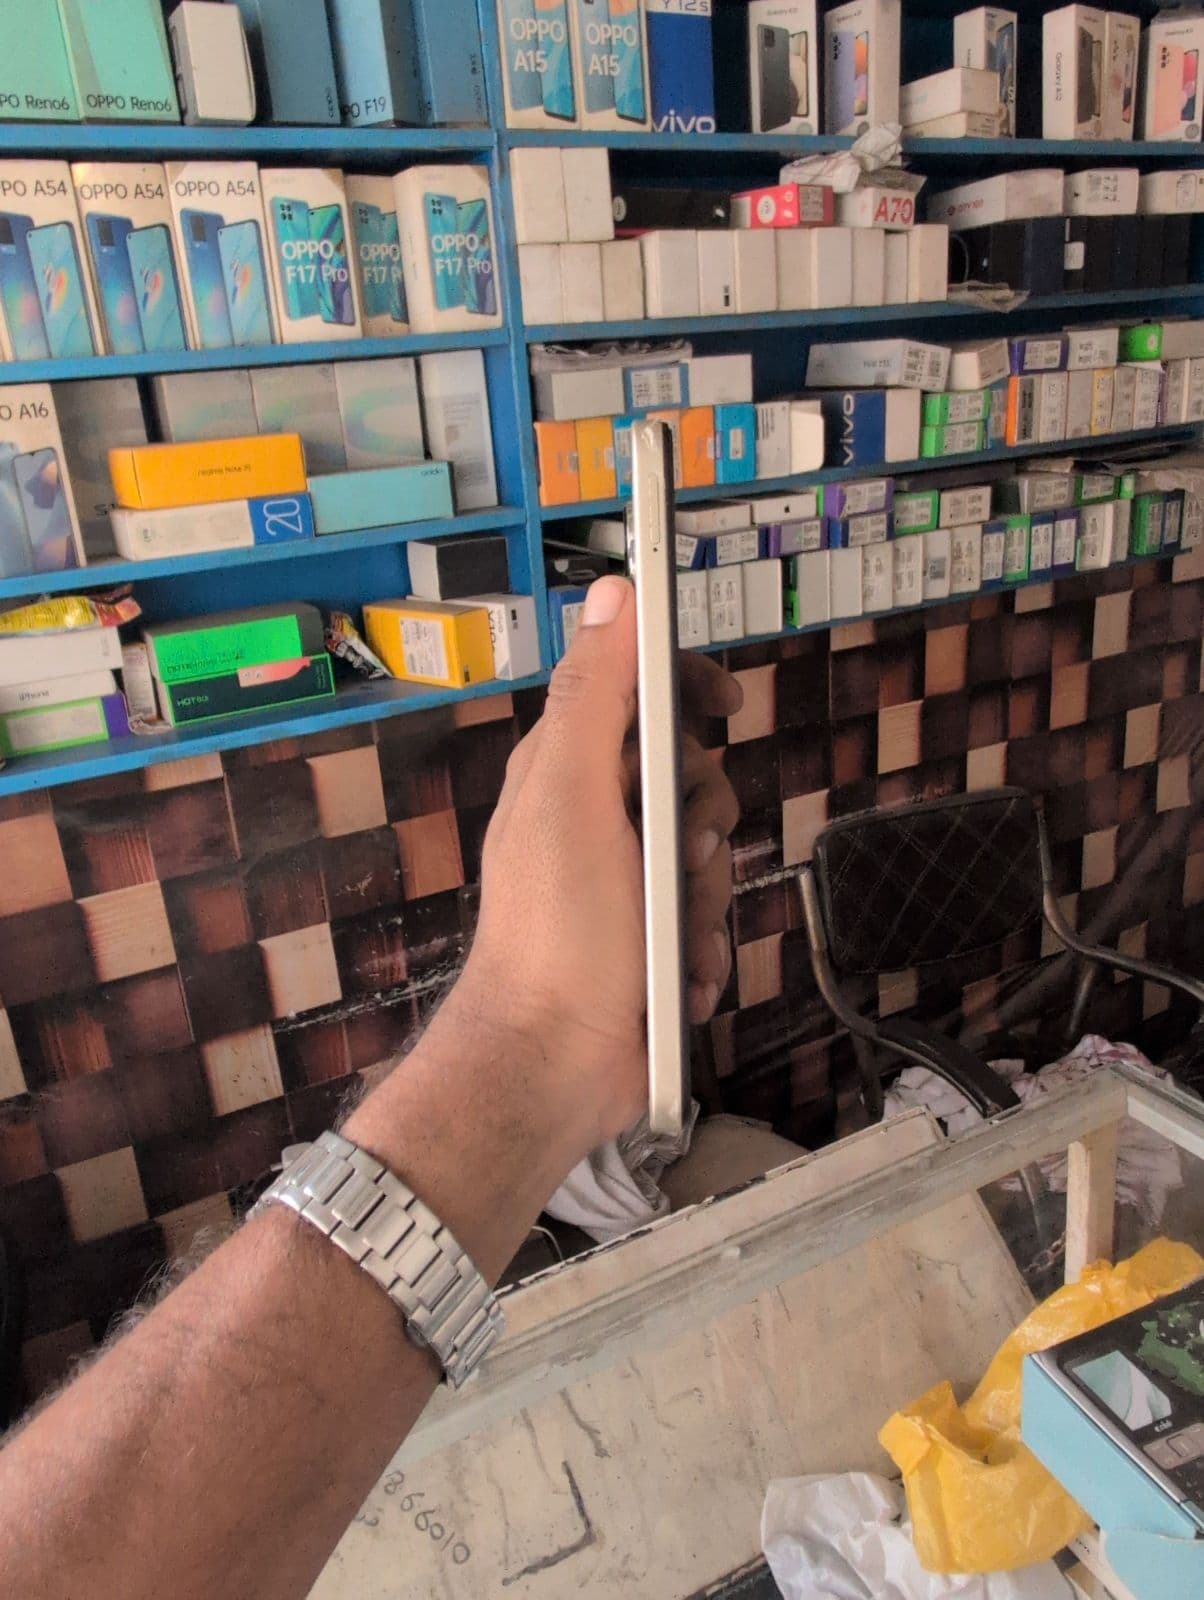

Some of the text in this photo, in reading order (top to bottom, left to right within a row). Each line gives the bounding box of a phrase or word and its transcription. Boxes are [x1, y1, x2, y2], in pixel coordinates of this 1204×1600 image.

[511, 17, 565, 43] OPPO
[585, 22, 637, 48] OPPO
[514, 49, 548, 73] A15
[588, 53, 621, 77] A15
[25, 95, 70, 111] Reno6
[86, 94, 172, 113] OPPO Reno6
[365, 96, 386, 116] F19
[652, 108, 716, 134] vivo
[34, 179, 68, 197] A54
[79, 183, 165, 200] OPPO A54
[174, 179, 256, 197] OPPO A54
[873, 196, 914, 224] A70
[281, 239, 335, 260] OPPO
[361, 244, 401, 261] OPPO
[431, 232, 479, 253] OPPO
[286, 262, 349, 285] F17 Pro
[363, 265, 387, 286] F17
[435, 256, 492, 277] F17 Pro
[19, 401, 49, 420] A16
[840, 393, 856, 466] vivo
[263, 498, 303, 536] 20
